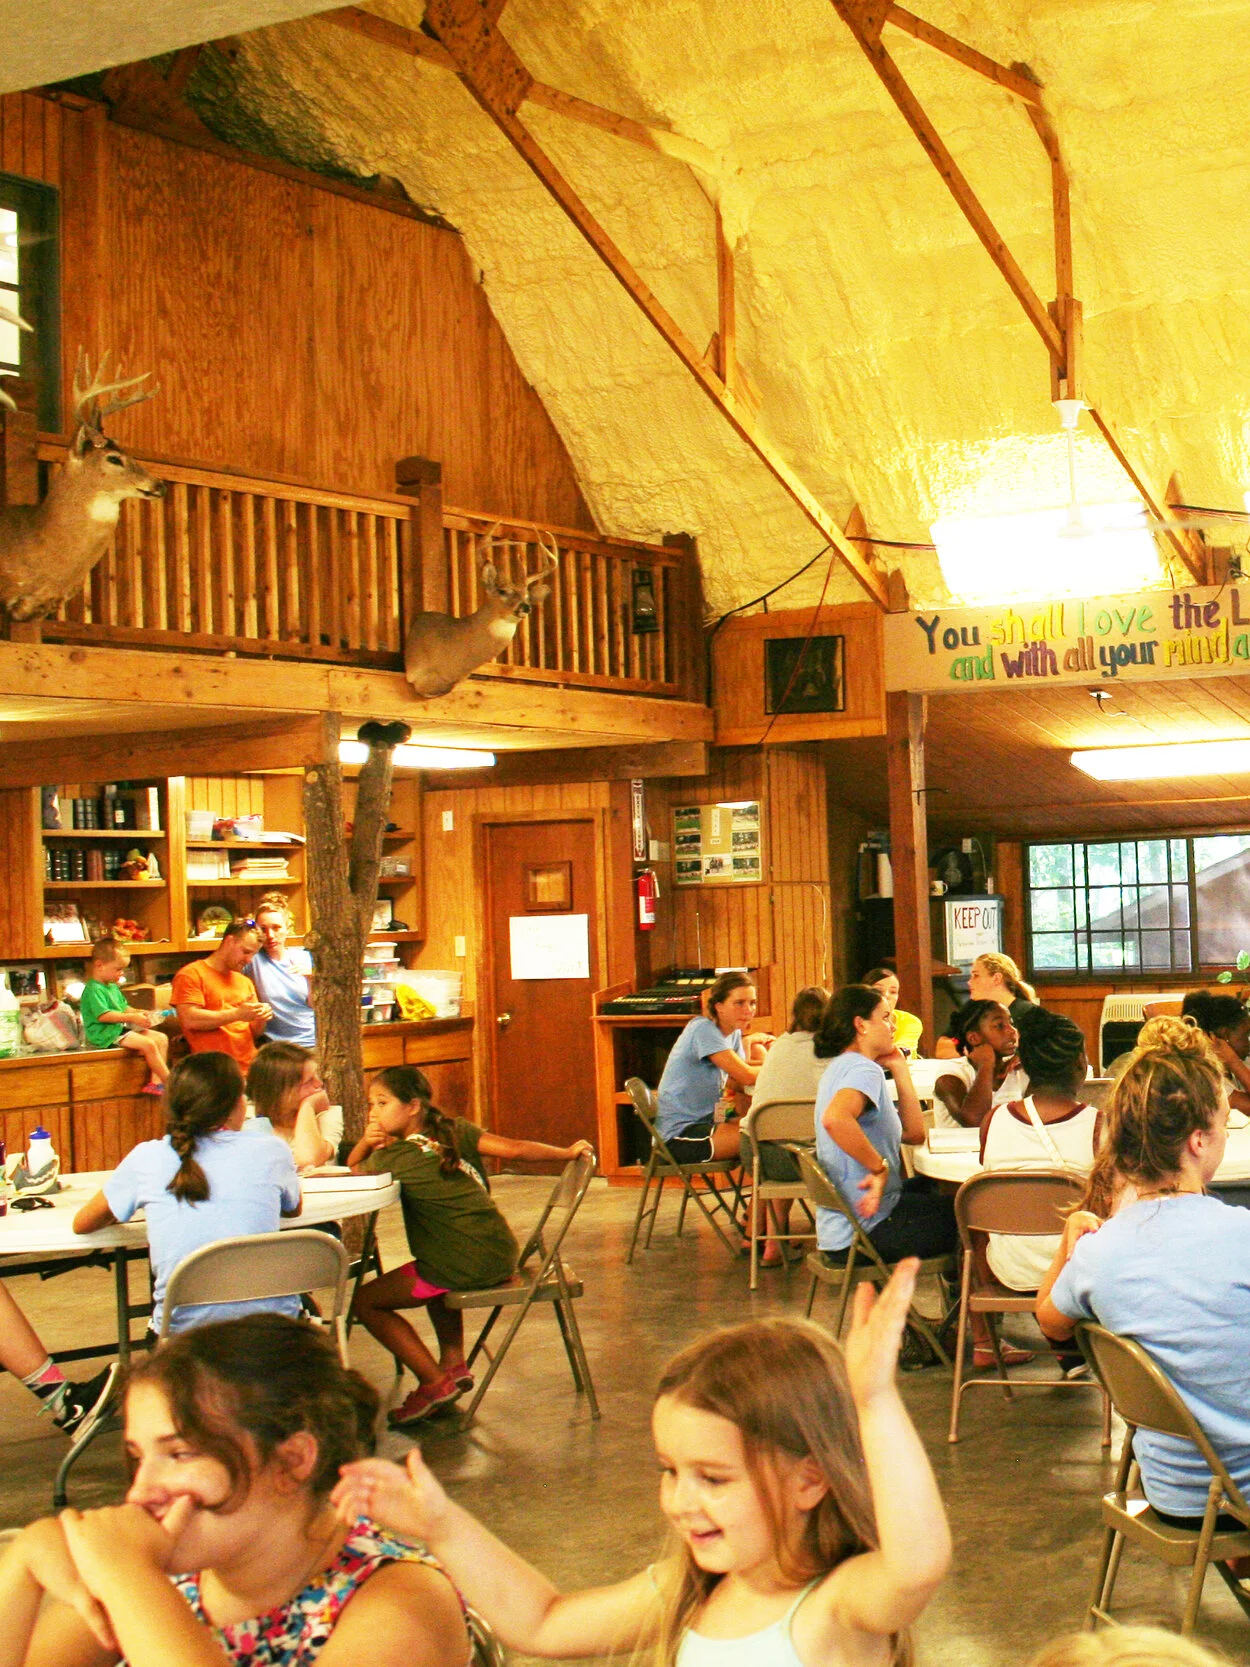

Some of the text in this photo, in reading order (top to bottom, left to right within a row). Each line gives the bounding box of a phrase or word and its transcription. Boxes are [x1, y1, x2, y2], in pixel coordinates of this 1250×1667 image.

[915, 615, 981, 654] You
[990, 602, 1066, 646] shall
[1079, 601, 1156, 637] love
[1168, 592, 1220, 630] the
[950, 645, 995, 681] and
[1000, 641, 1060, 678] with
[1063, 636, 1096, 672] all
[1099, 640, 1159, 678] your
[954, 907, 981, 930] KEEP
